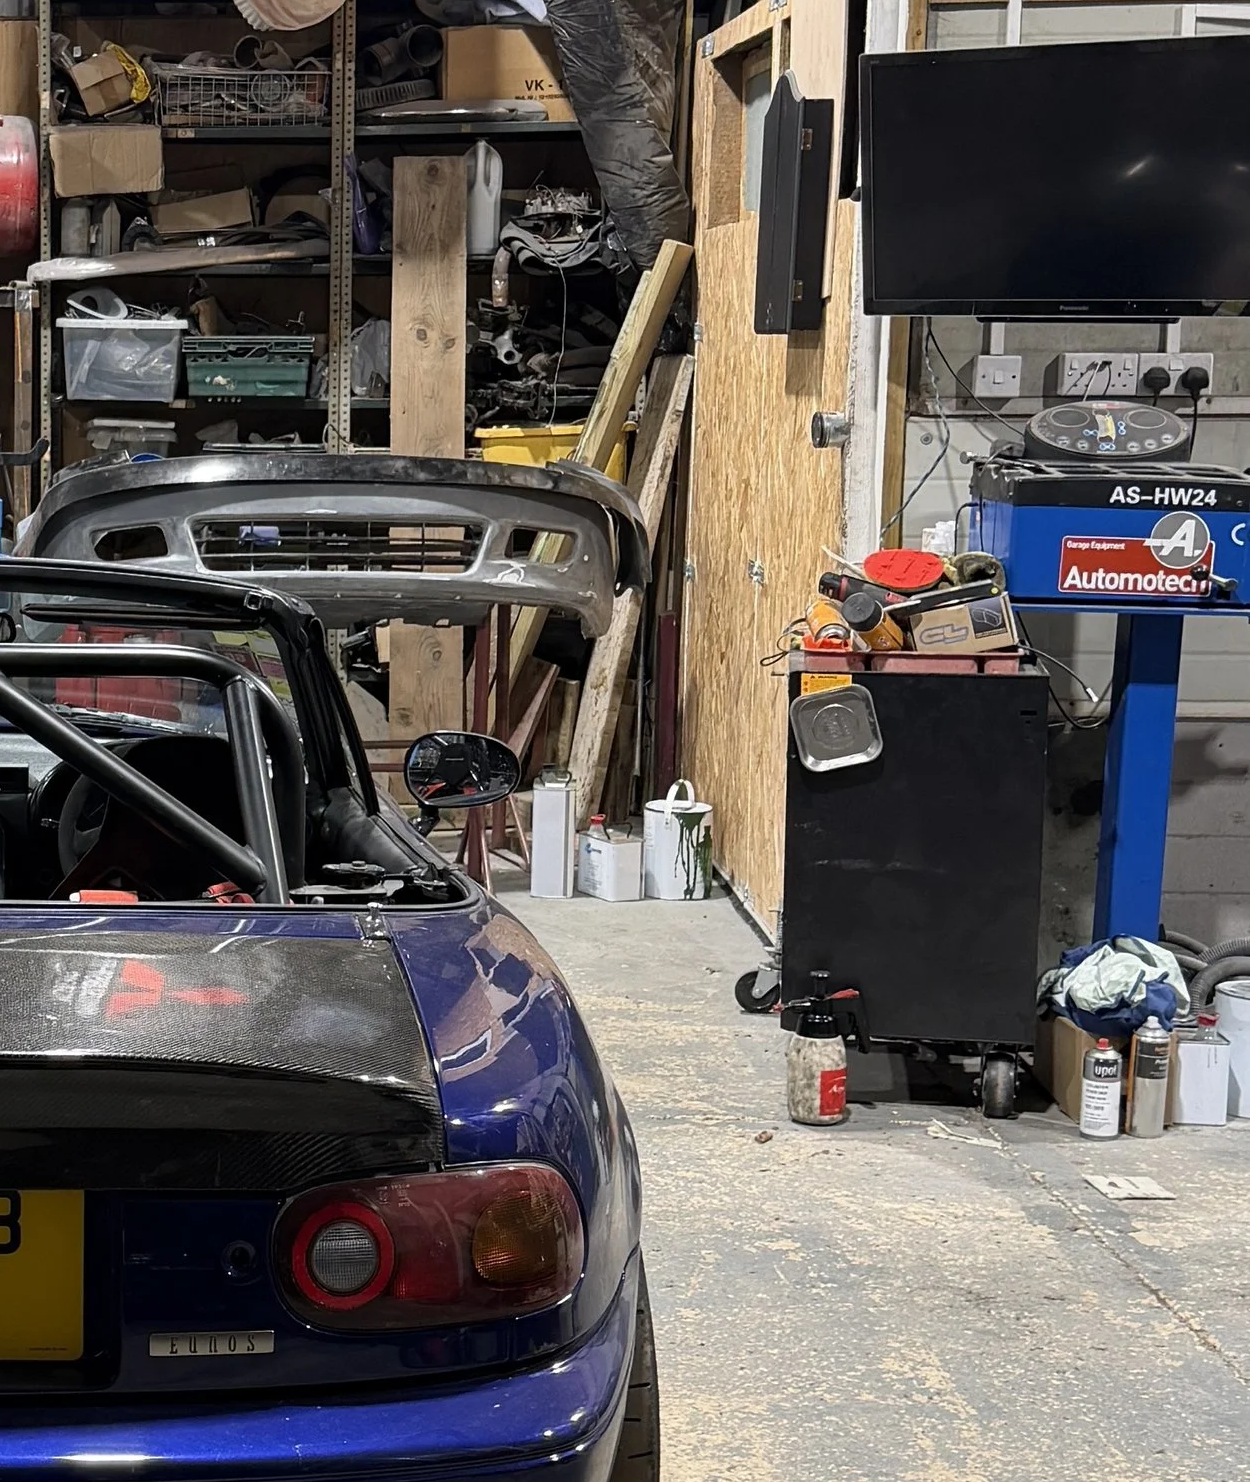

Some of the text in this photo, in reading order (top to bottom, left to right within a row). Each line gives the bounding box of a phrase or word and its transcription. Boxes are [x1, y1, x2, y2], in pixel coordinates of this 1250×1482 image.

[525, 79, 545, 91] VK
[1109, 485, 1218, 507] AS-HW24
[1066, 540, 1126, 551] Garage Equipment
